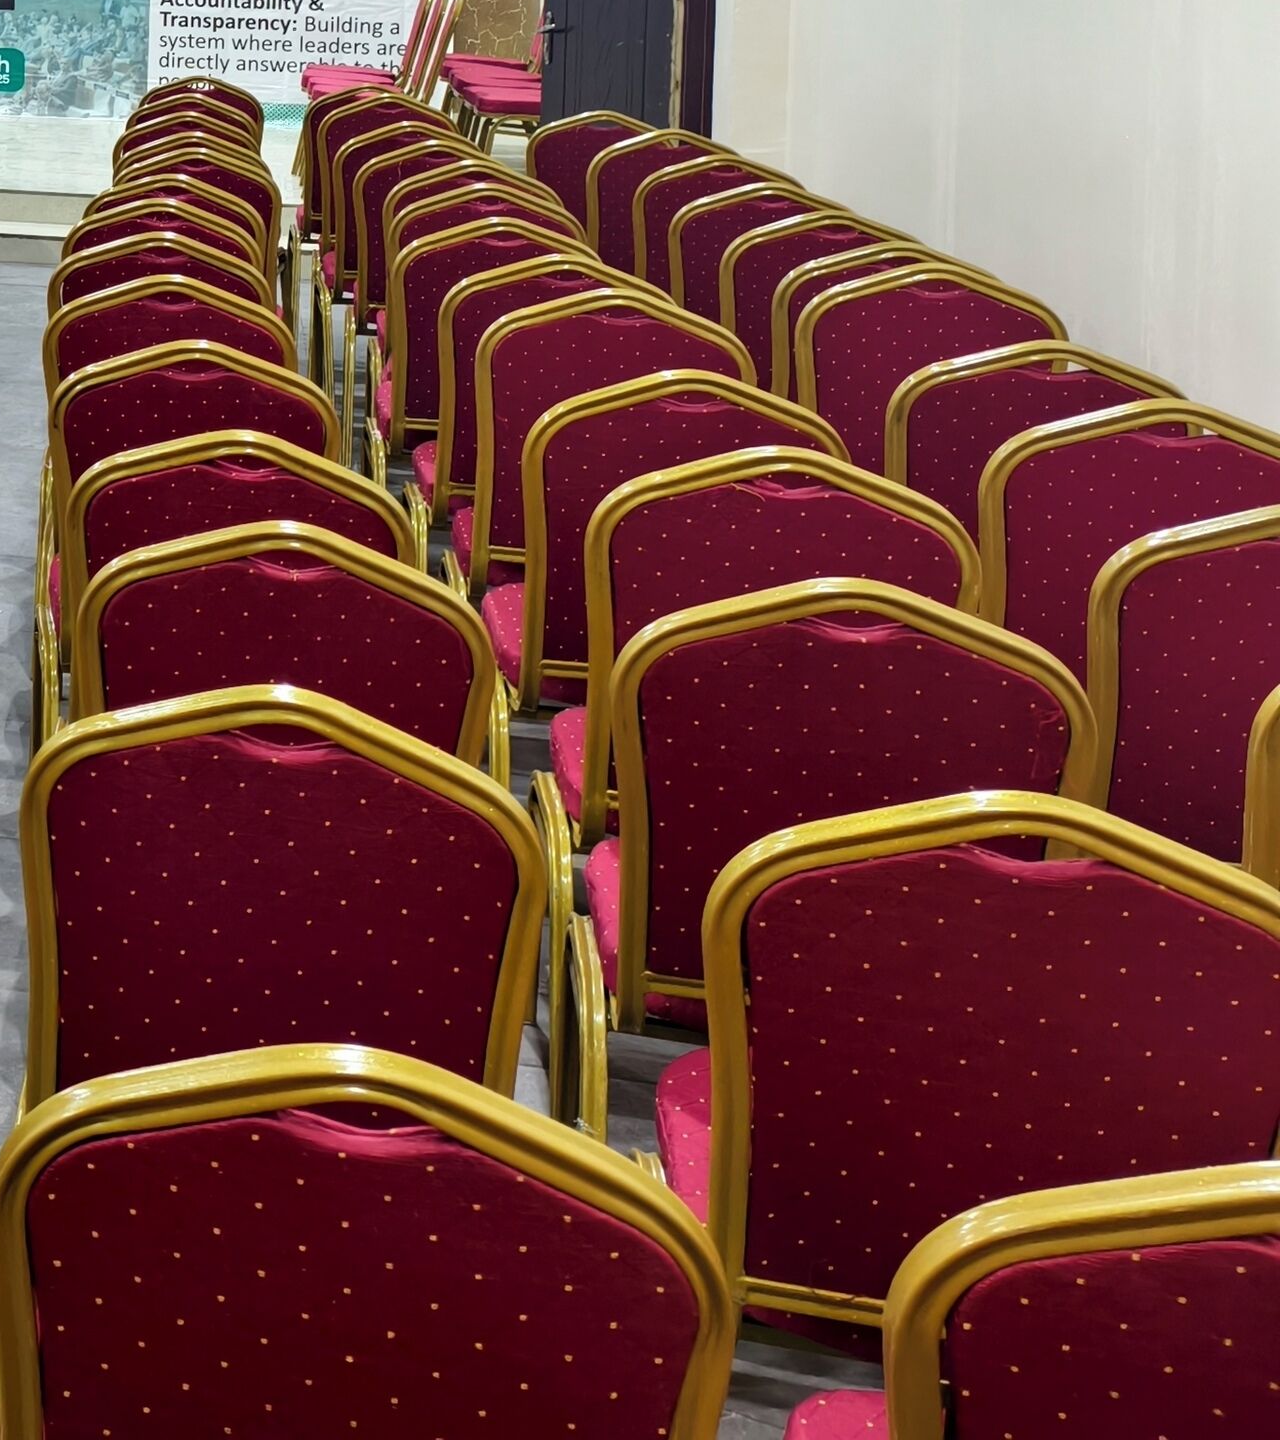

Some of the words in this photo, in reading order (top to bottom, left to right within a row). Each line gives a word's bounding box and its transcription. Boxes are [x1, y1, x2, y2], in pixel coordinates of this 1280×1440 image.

[159, 12, 298, 35] Transparency:
[304, 15, 383, 38] Building
[389, 22, 400, 35] a
[158, 33, 225, 51] system
[231, 35, 293, 52] where
[299, 36, 371, 56] leaders
[376, 42, 407, 57] are
[158, 52, 230, 74] directly
